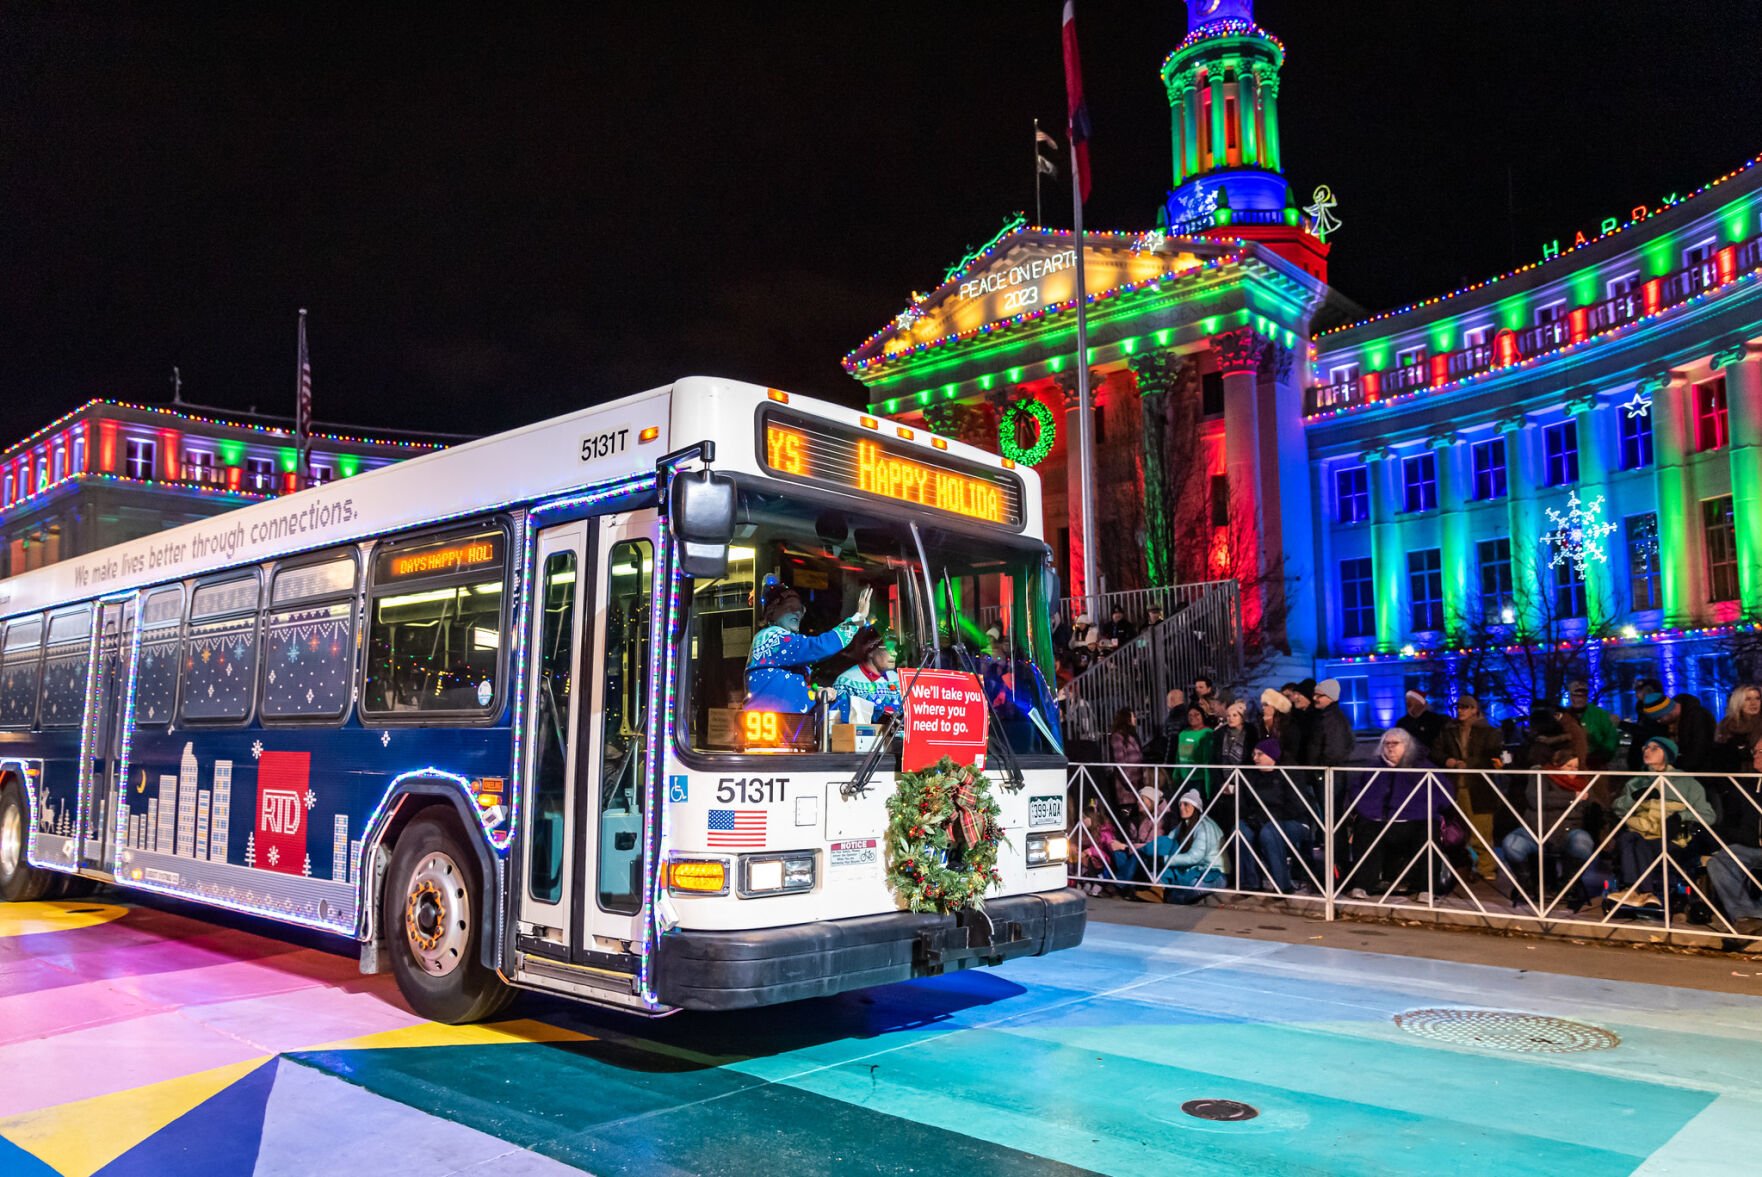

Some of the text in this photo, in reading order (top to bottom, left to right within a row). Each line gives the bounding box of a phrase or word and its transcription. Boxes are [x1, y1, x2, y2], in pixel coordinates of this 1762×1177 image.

[960, 271, 1008, 301] PEACE
[1009, 264, 1030, 286] ON
[1004, 286, 1038, 311] 2023
[581, 428, 629, 462] 5131T
[767, 428, 800, 474] YS
[936, 472, 998, 522] HOLIDA
[75, 499, 358, 588] We make lives better through connections.
[912, 685, 982, 705] We'll take you
[913, 701, 966, 719] where you
[746, 711, 777, 741] 99
[913, 718, 969, 736] need to go.
[716, 777, 790, 804] 5131T
[261, 788, 301, 835] RTD
[840, 840, 867, 850] NOTICE
